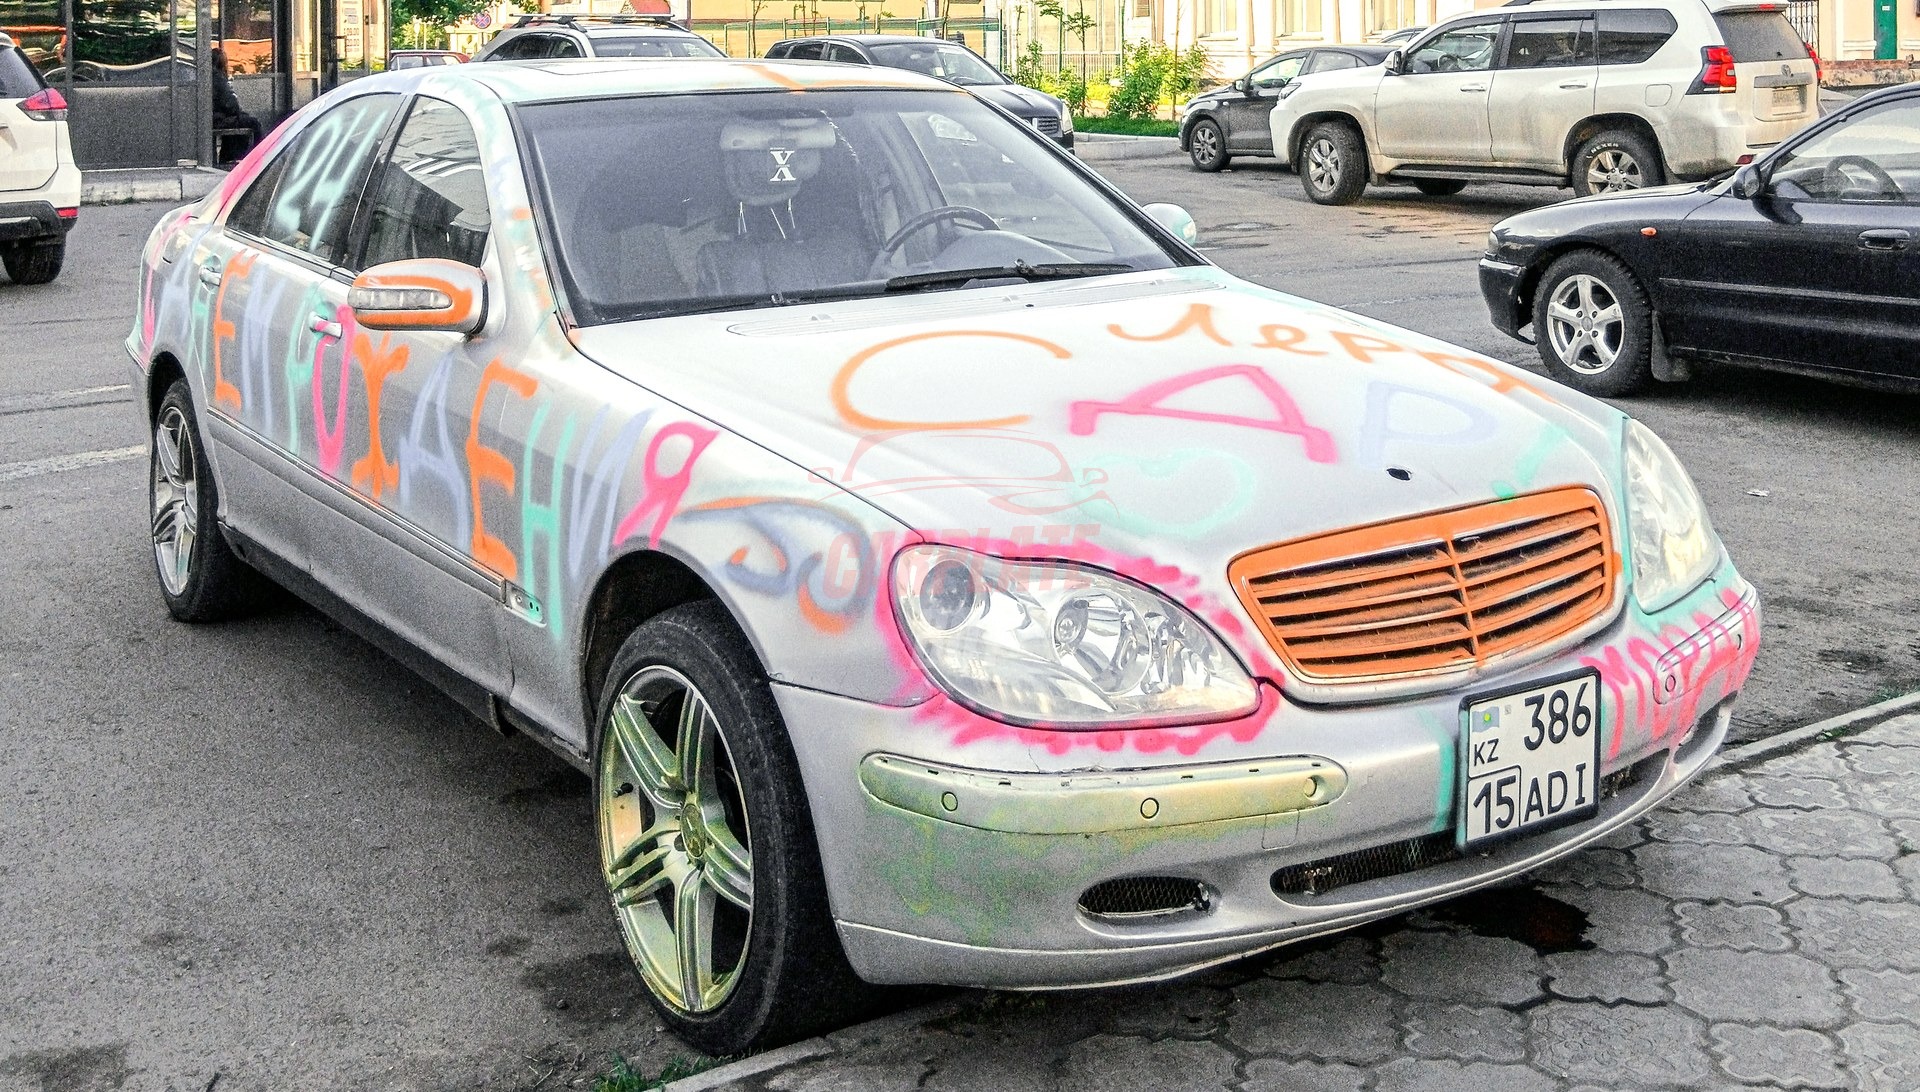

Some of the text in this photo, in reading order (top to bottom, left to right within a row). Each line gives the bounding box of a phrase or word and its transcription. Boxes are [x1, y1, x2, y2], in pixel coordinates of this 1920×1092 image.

[1473, 682, 1592, 767] KZ 386
[1472, 763, 1588, 835] 15 ADI
